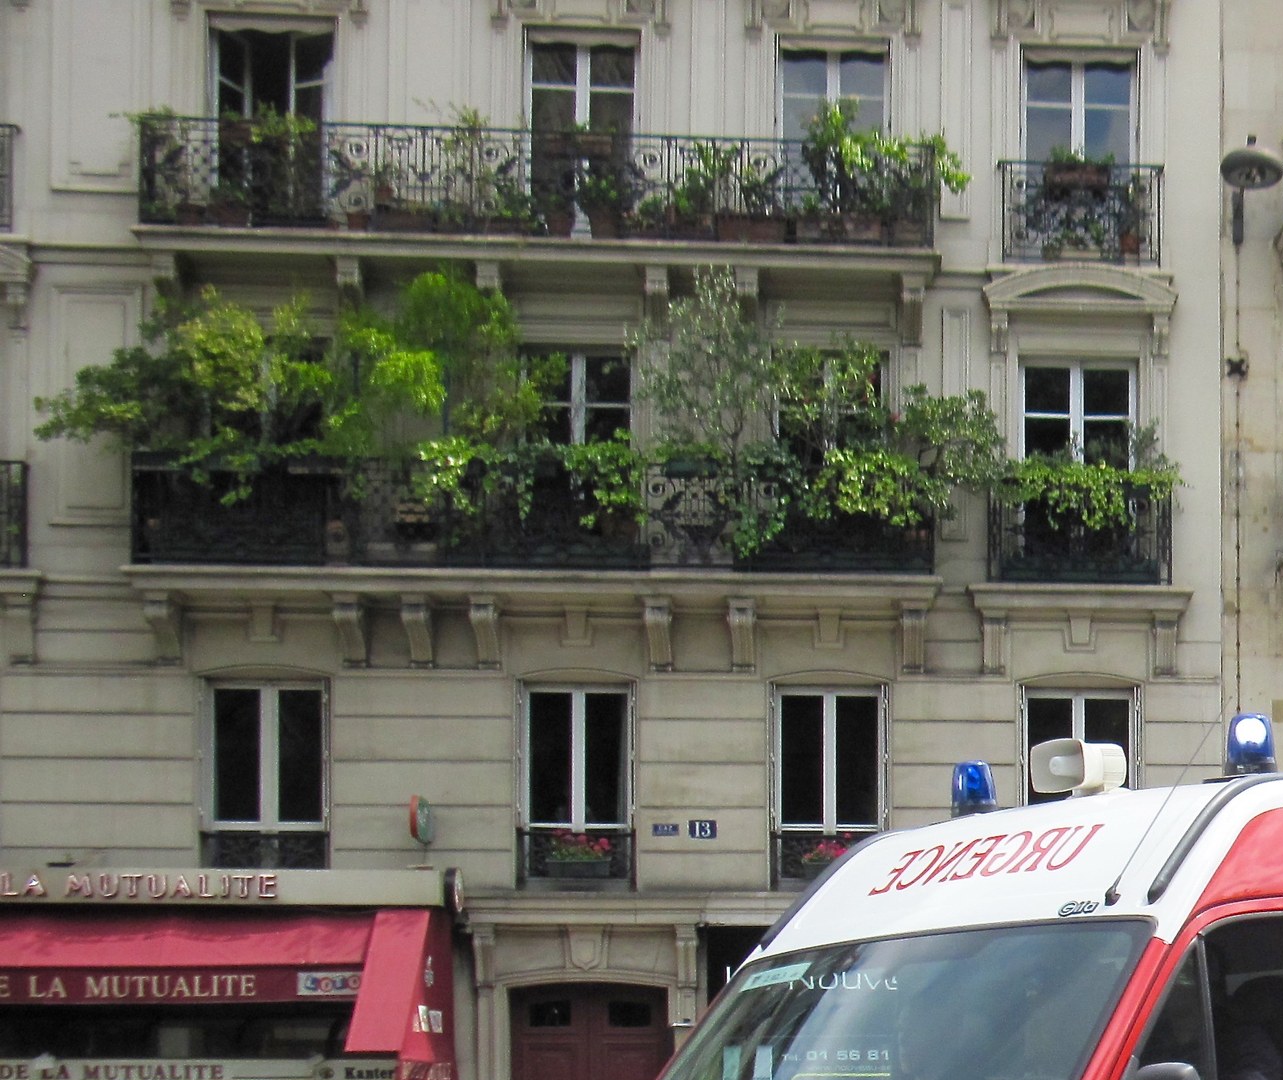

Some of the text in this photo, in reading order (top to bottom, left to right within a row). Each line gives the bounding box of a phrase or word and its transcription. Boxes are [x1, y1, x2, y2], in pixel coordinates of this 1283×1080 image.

[695, 821, 711, 838] 13
[1, 873, 278, 899] LA MUTUALITE
[28, 975, 68, 998] LA
[84, 974, 257, 998] MUTUALITE
[806, 1050, 828, 1061] 01
[836, 1050, 861, 1061] 56
[867, 1050, 890, 1061] 81
[0, 1064, 224, 1080] DE LA MUTUALITE
